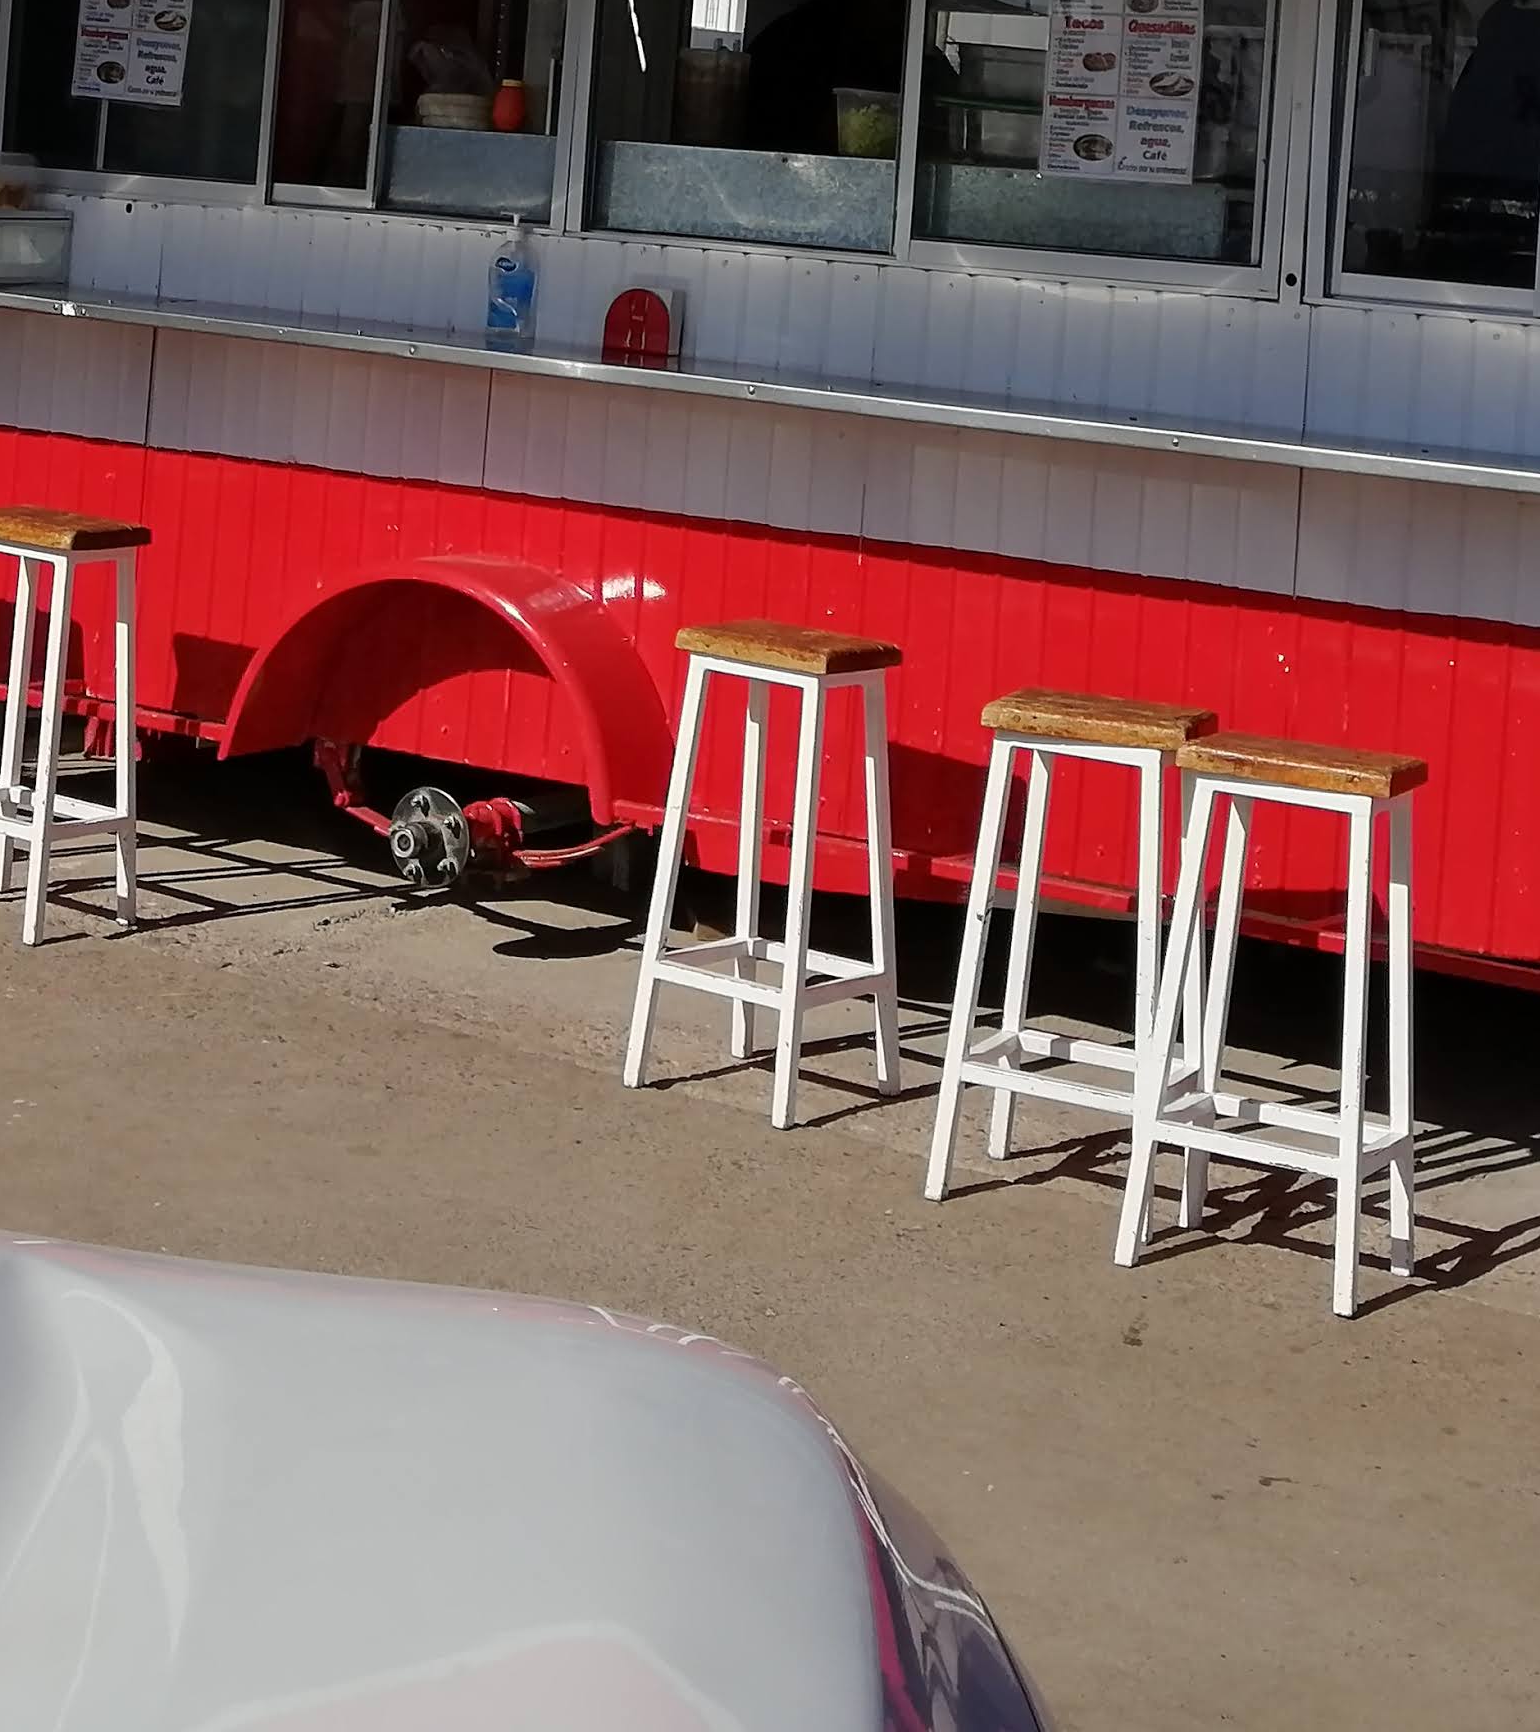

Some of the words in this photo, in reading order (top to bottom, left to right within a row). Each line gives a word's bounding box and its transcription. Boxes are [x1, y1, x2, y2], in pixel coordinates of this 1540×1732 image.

[1064, 15, 1105, 30] Tacos
[1128, 19, 1197, 35] Quesadillas
[1142, 149, 1168, 161] Café
